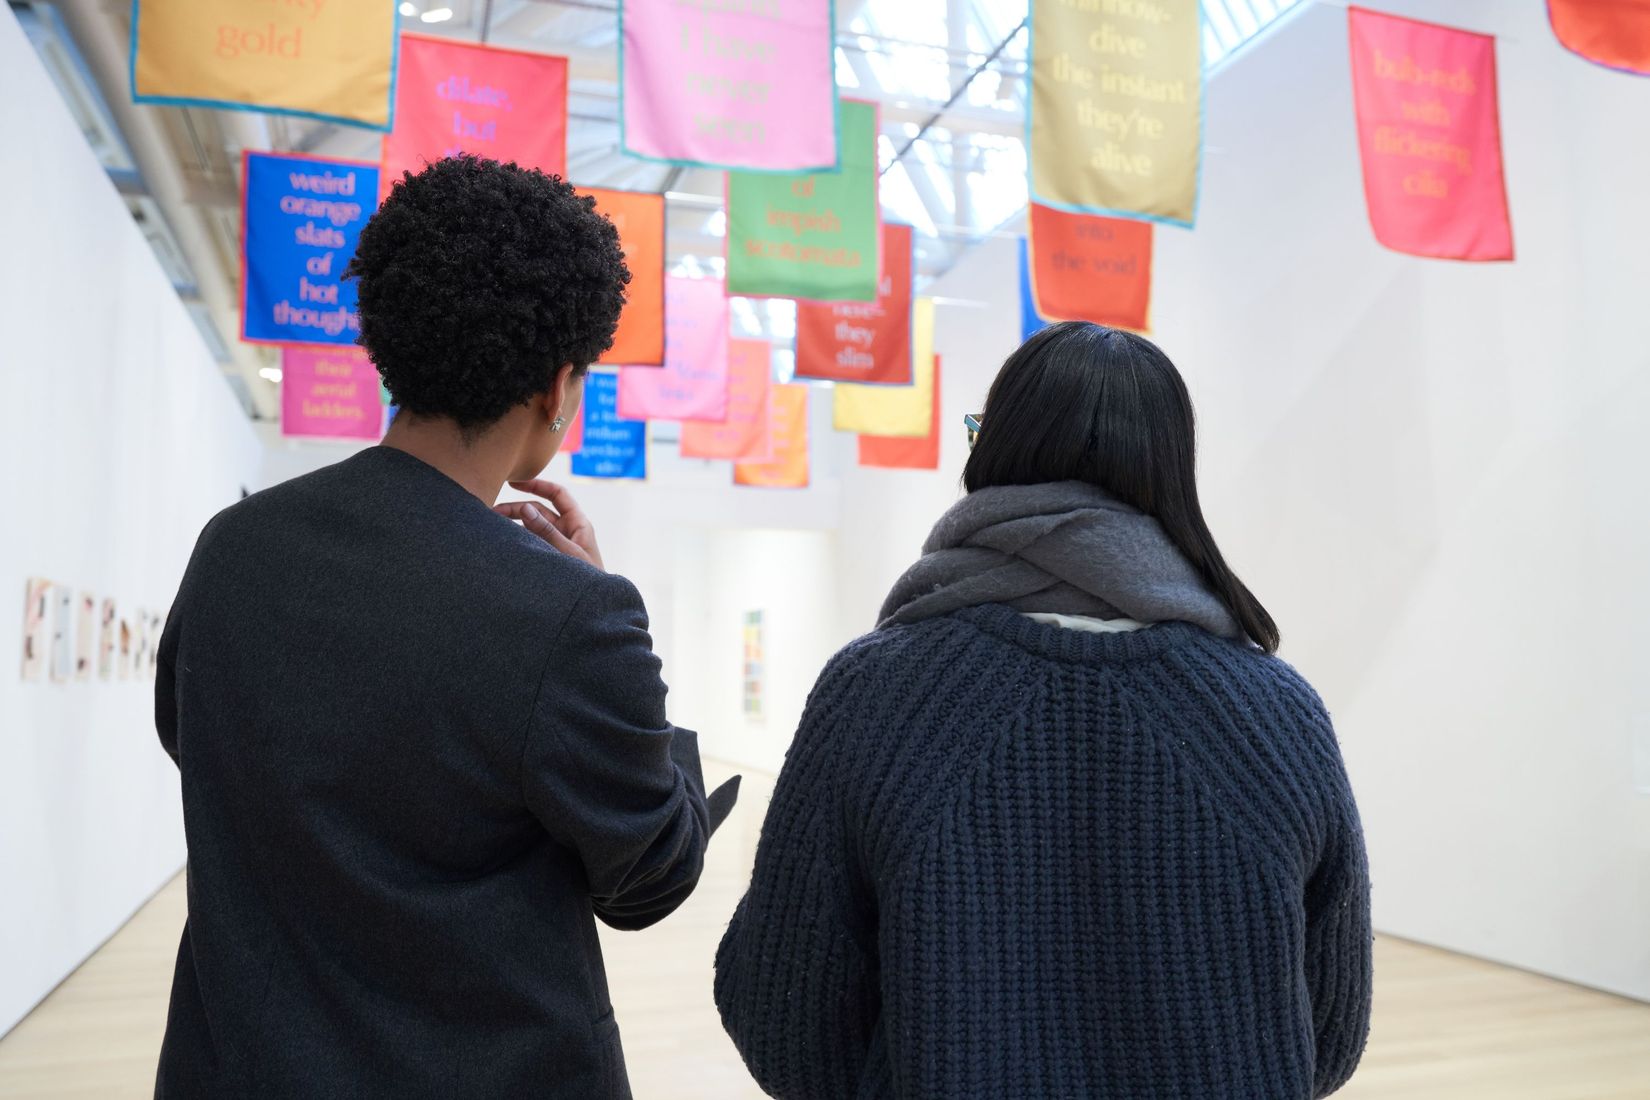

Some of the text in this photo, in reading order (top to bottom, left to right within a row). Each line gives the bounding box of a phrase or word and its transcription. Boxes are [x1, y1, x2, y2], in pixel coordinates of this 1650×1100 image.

[214, 22, 303, 60] gold
[702, 26, 780, 65] have
[1088, 23, 1147, 59] dive
[686, 73, 775, 107] never
[1053, 52, 1186, 104] the instant
[453, 110, 497, 144] but
[692, 112, 767, 145] seen
[1077, 97, 1165, 142] they're
[1091, 140, 1152, 178] alive
[289, 170, 356, 196] weird
[280, 195, 362, 227] orange
[295, 220, 346, 249] slats
[306, 251, 334, 276] of
[1050, 249, 1085, 272] the
[300, 276, 339, 305] hot
[273, 300, 361, 336] though
[834, 319, 876, 348] they
